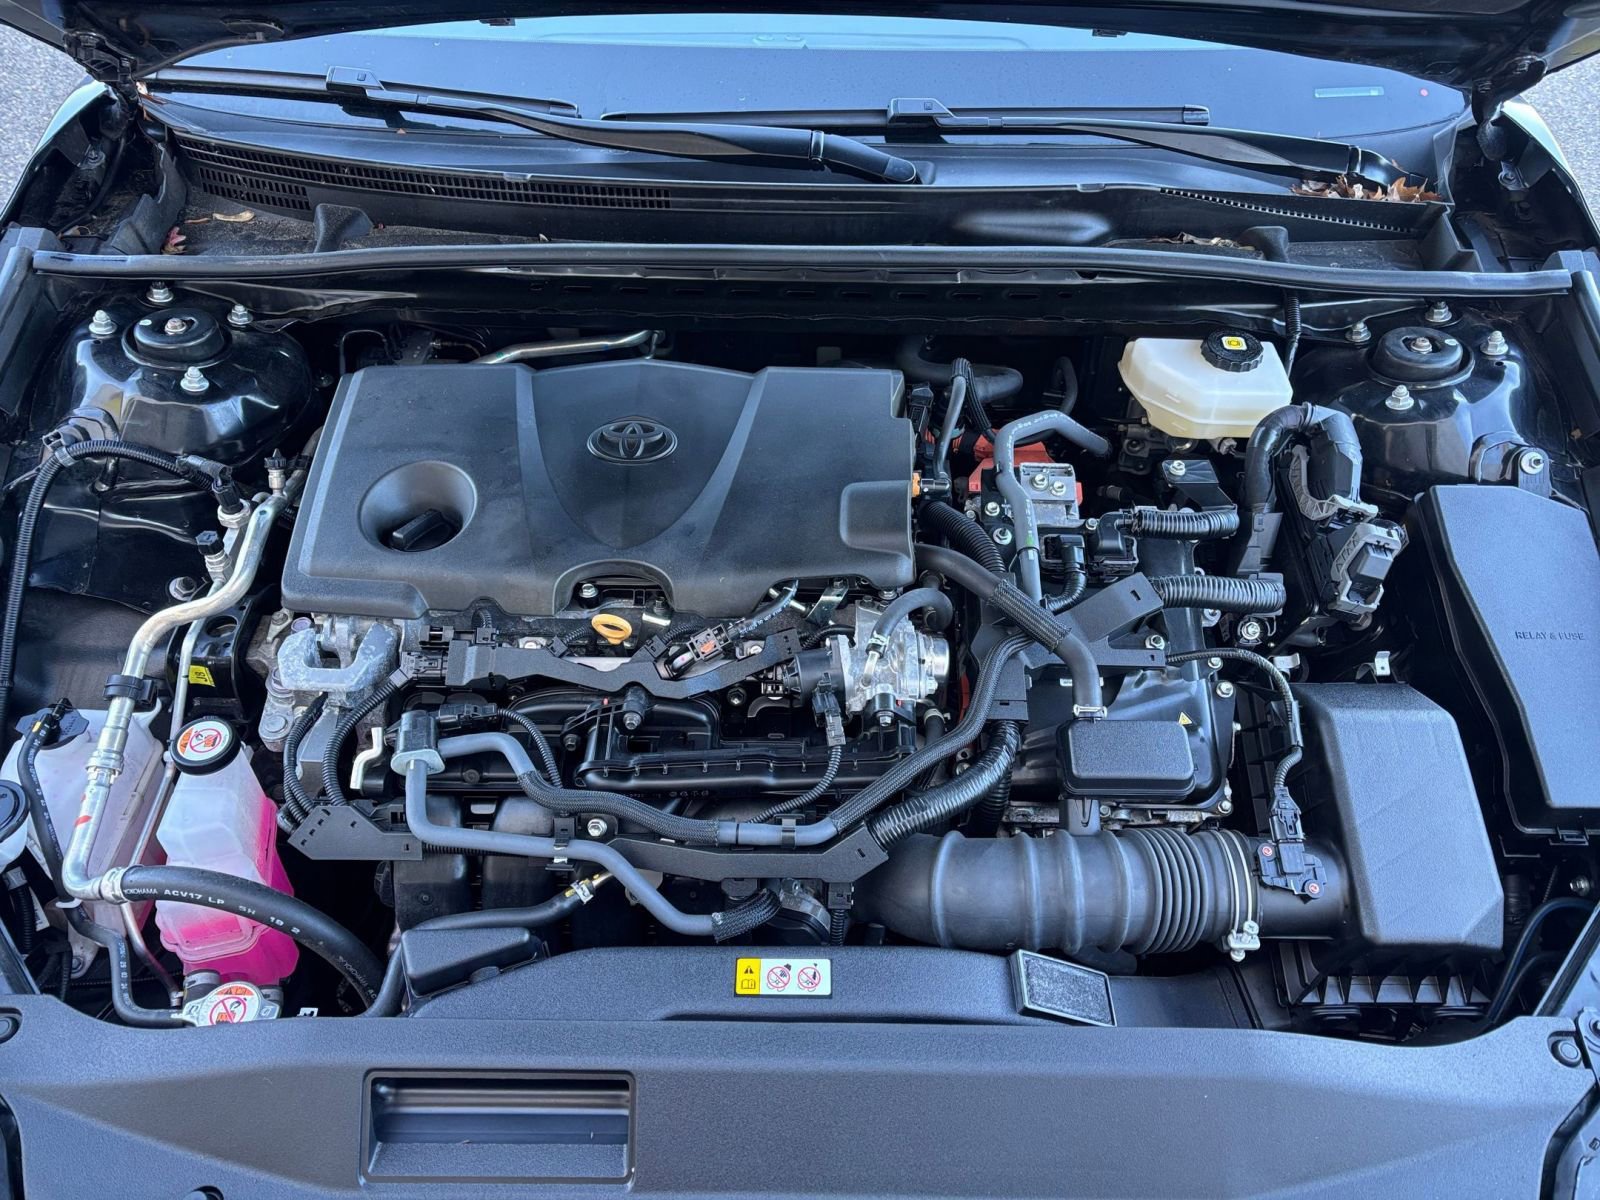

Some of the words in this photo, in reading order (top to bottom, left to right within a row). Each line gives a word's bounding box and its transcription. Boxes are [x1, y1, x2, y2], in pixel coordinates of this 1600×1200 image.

[1514, 631, 1547, 640] RELAY
[1558, 632, 1586, 640] FUSE
[163, 889, 203, 900] ACV17
[208, 896, 225, 905] LP
